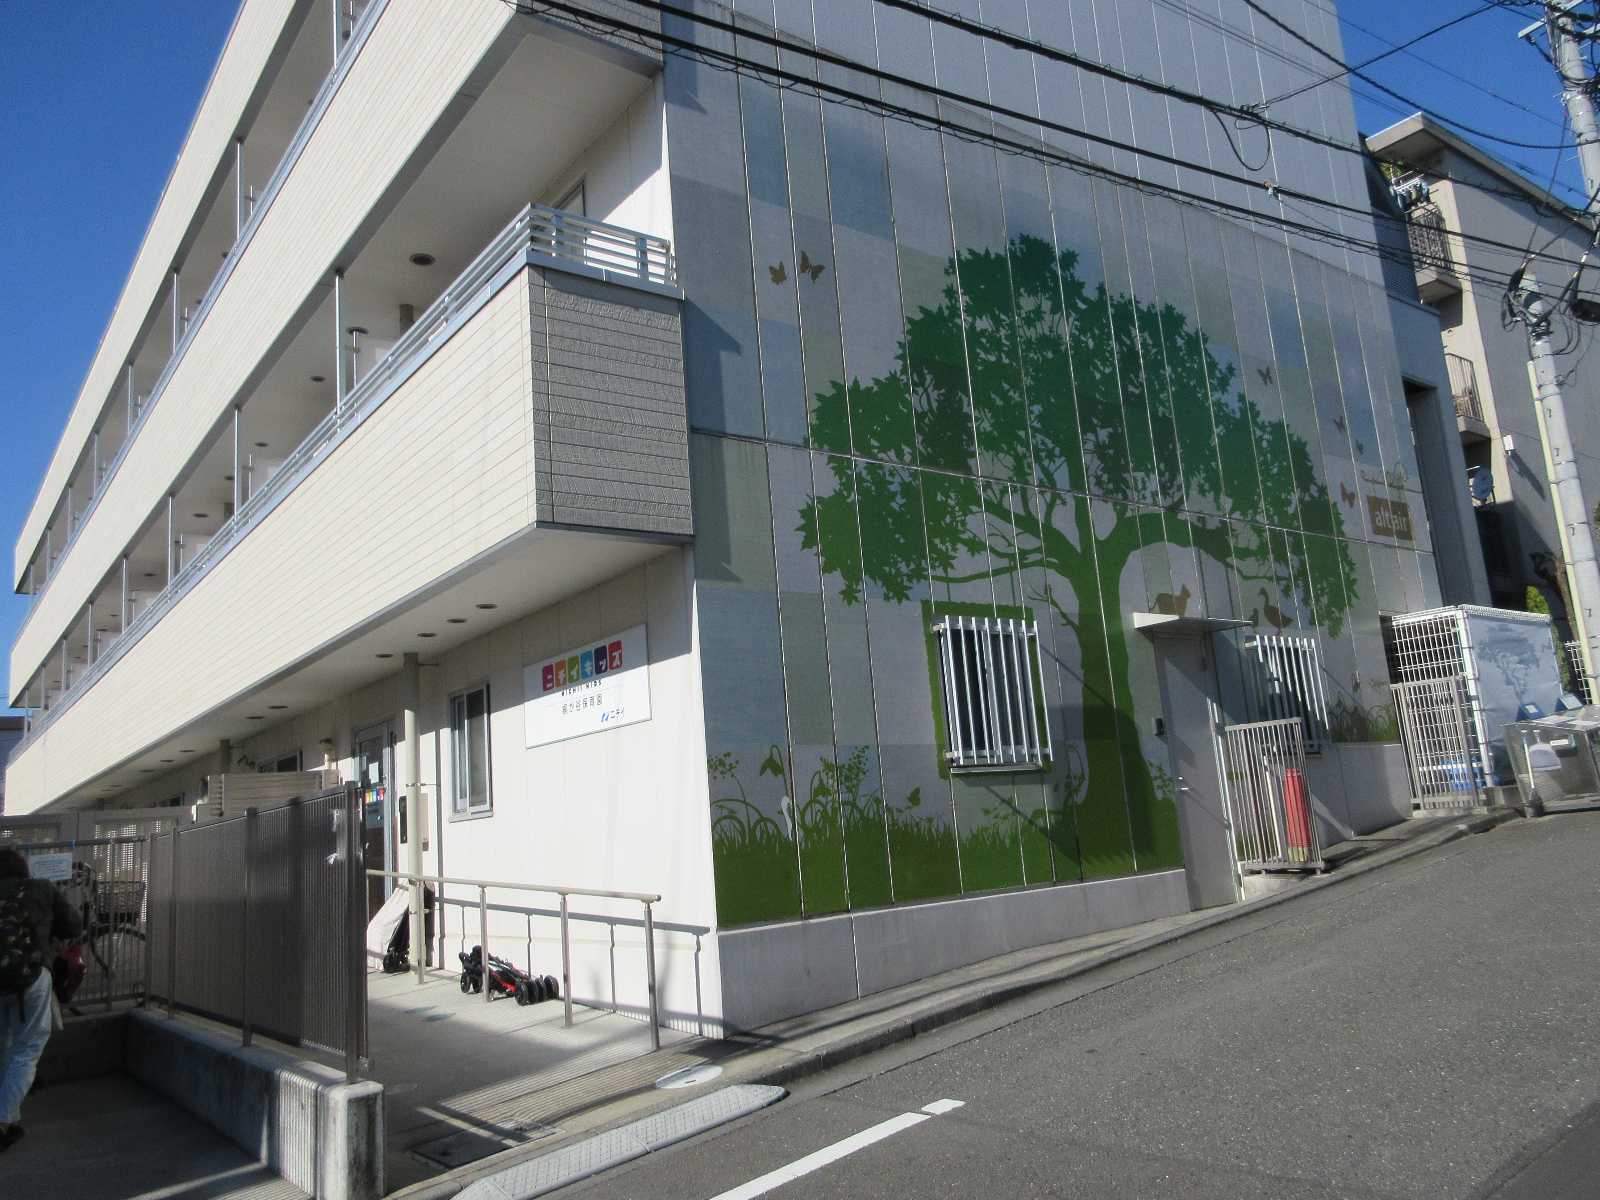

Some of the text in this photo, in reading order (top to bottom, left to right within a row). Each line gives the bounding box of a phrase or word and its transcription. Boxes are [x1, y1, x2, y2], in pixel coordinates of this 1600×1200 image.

[544, 645, 622, 690] ニチイキッズ
